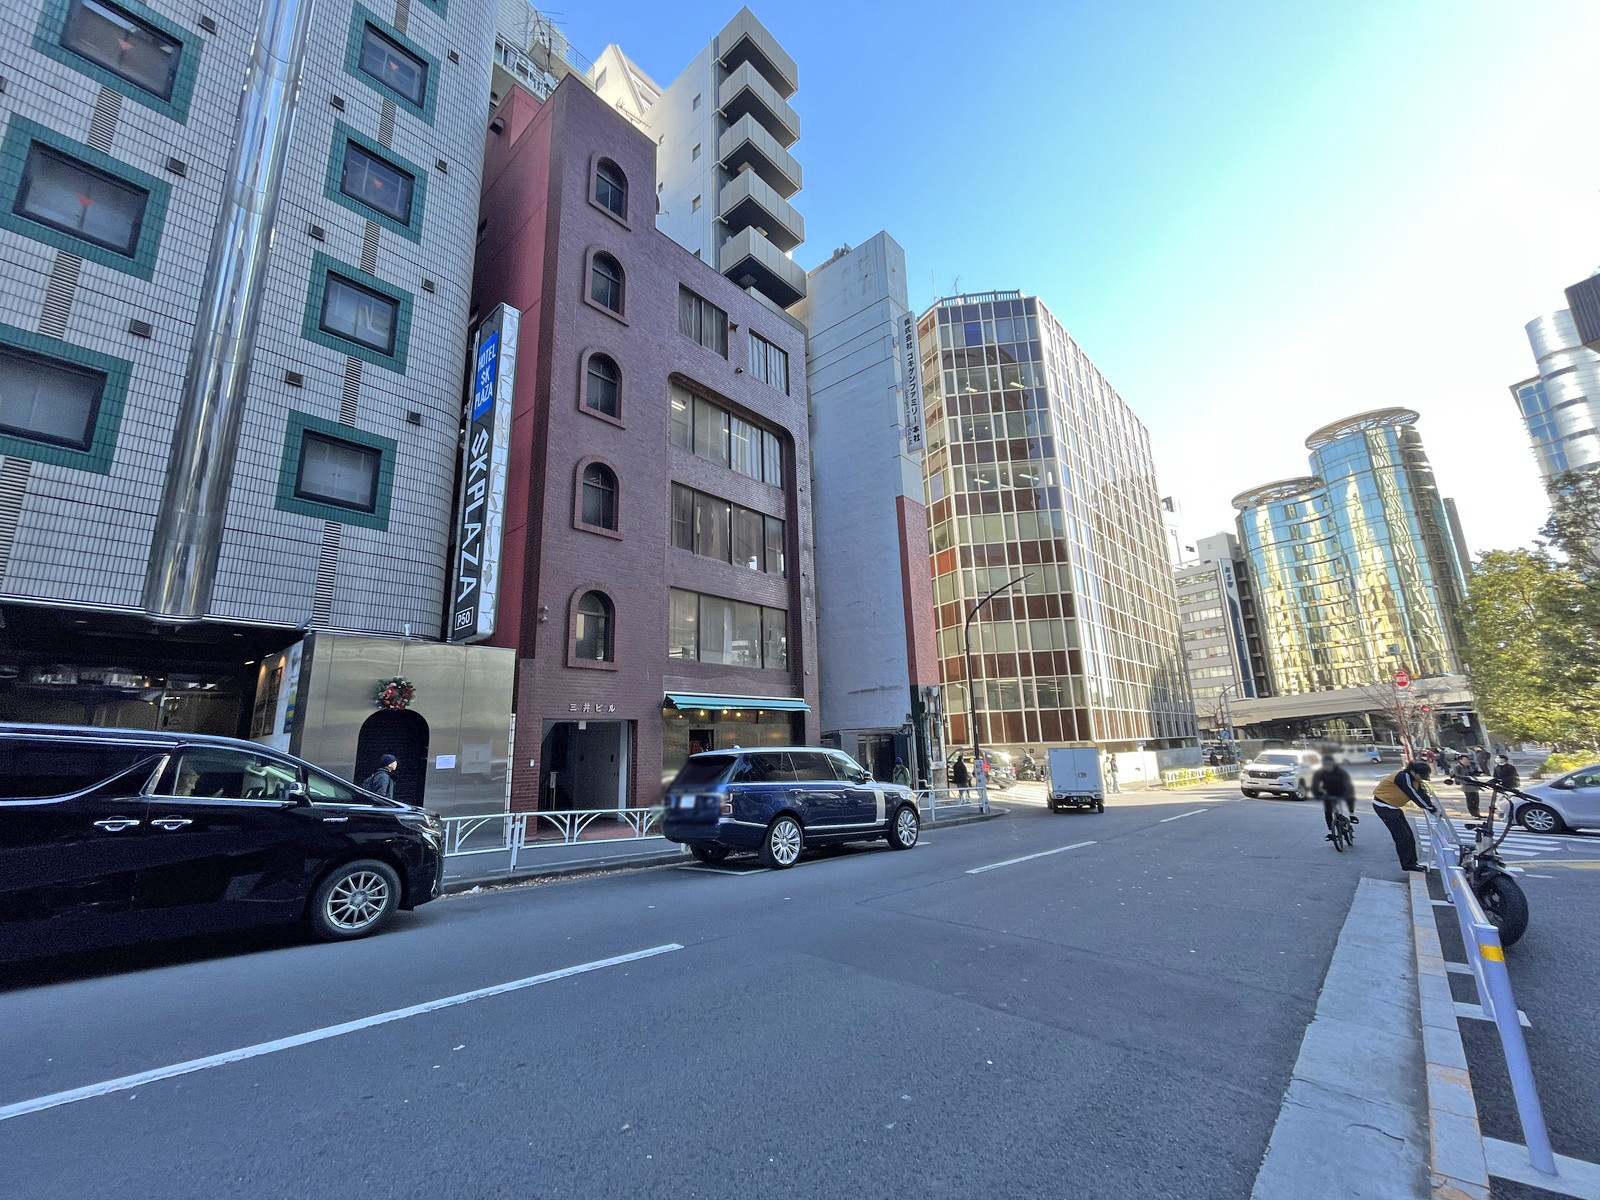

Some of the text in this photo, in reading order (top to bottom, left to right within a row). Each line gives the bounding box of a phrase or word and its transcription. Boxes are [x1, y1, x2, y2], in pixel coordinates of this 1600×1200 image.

[478, 343, 496, 372] HOTEL
[474, 381, 493, 410] PLAZA
[457, 611, 471, 627] P50
[569, 702, 616, 713] 三井ビル
